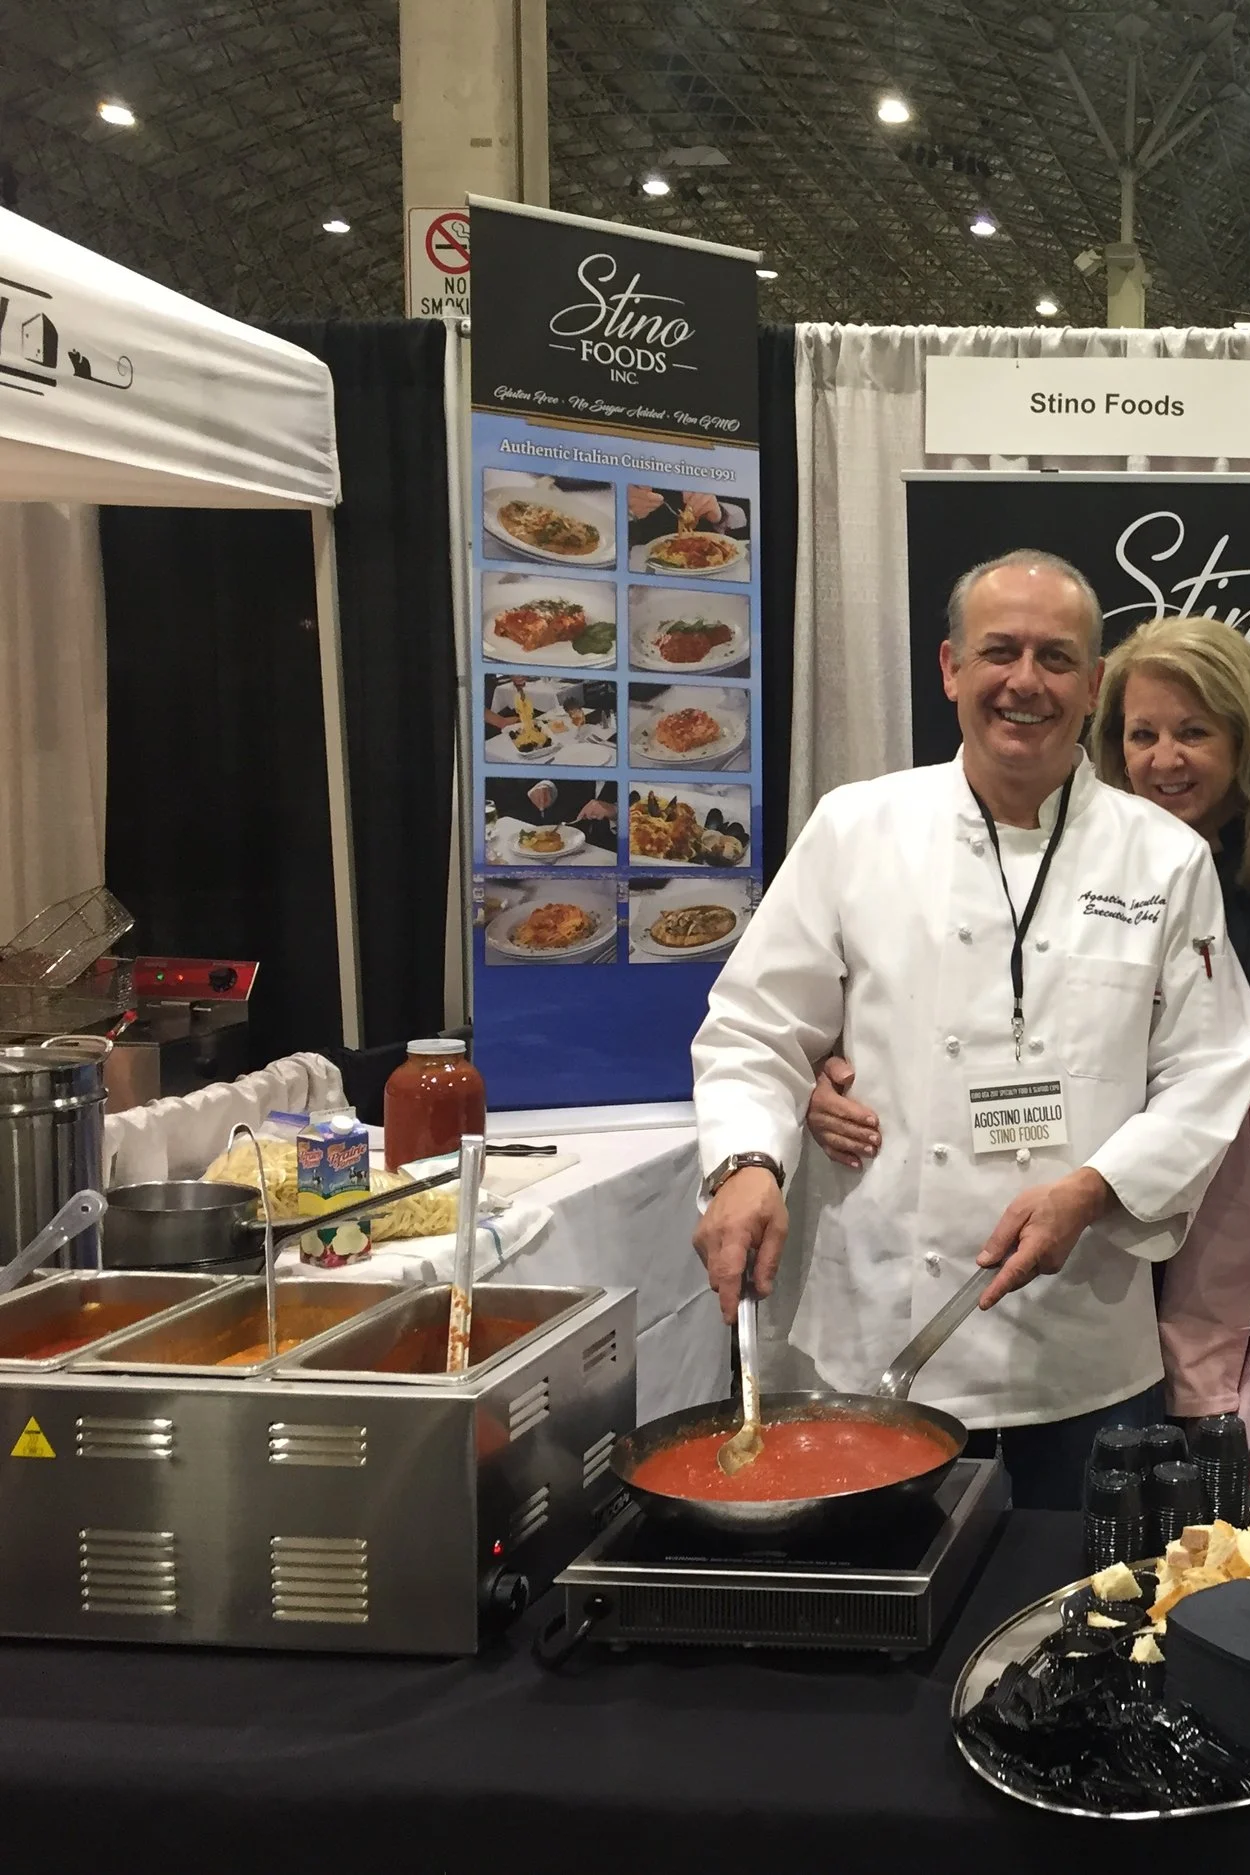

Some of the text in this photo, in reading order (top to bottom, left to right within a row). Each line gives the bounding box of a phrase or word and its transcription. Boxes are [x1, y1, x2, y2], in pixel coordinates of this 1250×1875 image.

[445, 276, 467, 294] NO
[421, 297, 470, 315] SMOKI
[549, 253, 696, 348] Stino
[580, 339, 667, 374] FOODS
[610, 369, 640, 385] INC.
[494, 386, 741, 433] Gluten Free No Sugar Added Non GMO
[1030, 392, 1185, 416] Stino Foods
[500, 439, 737, 482] Authentic Italian Cuisine since 1991
[1078, 890, 1126, 907] Agostin
[1083, 903, 1161, 925] Executive Chef
[974, 1104, 1062, 1128] AGOSTINO IACULLO
[990, 1124, 1049, 1145] STINO FOODS
